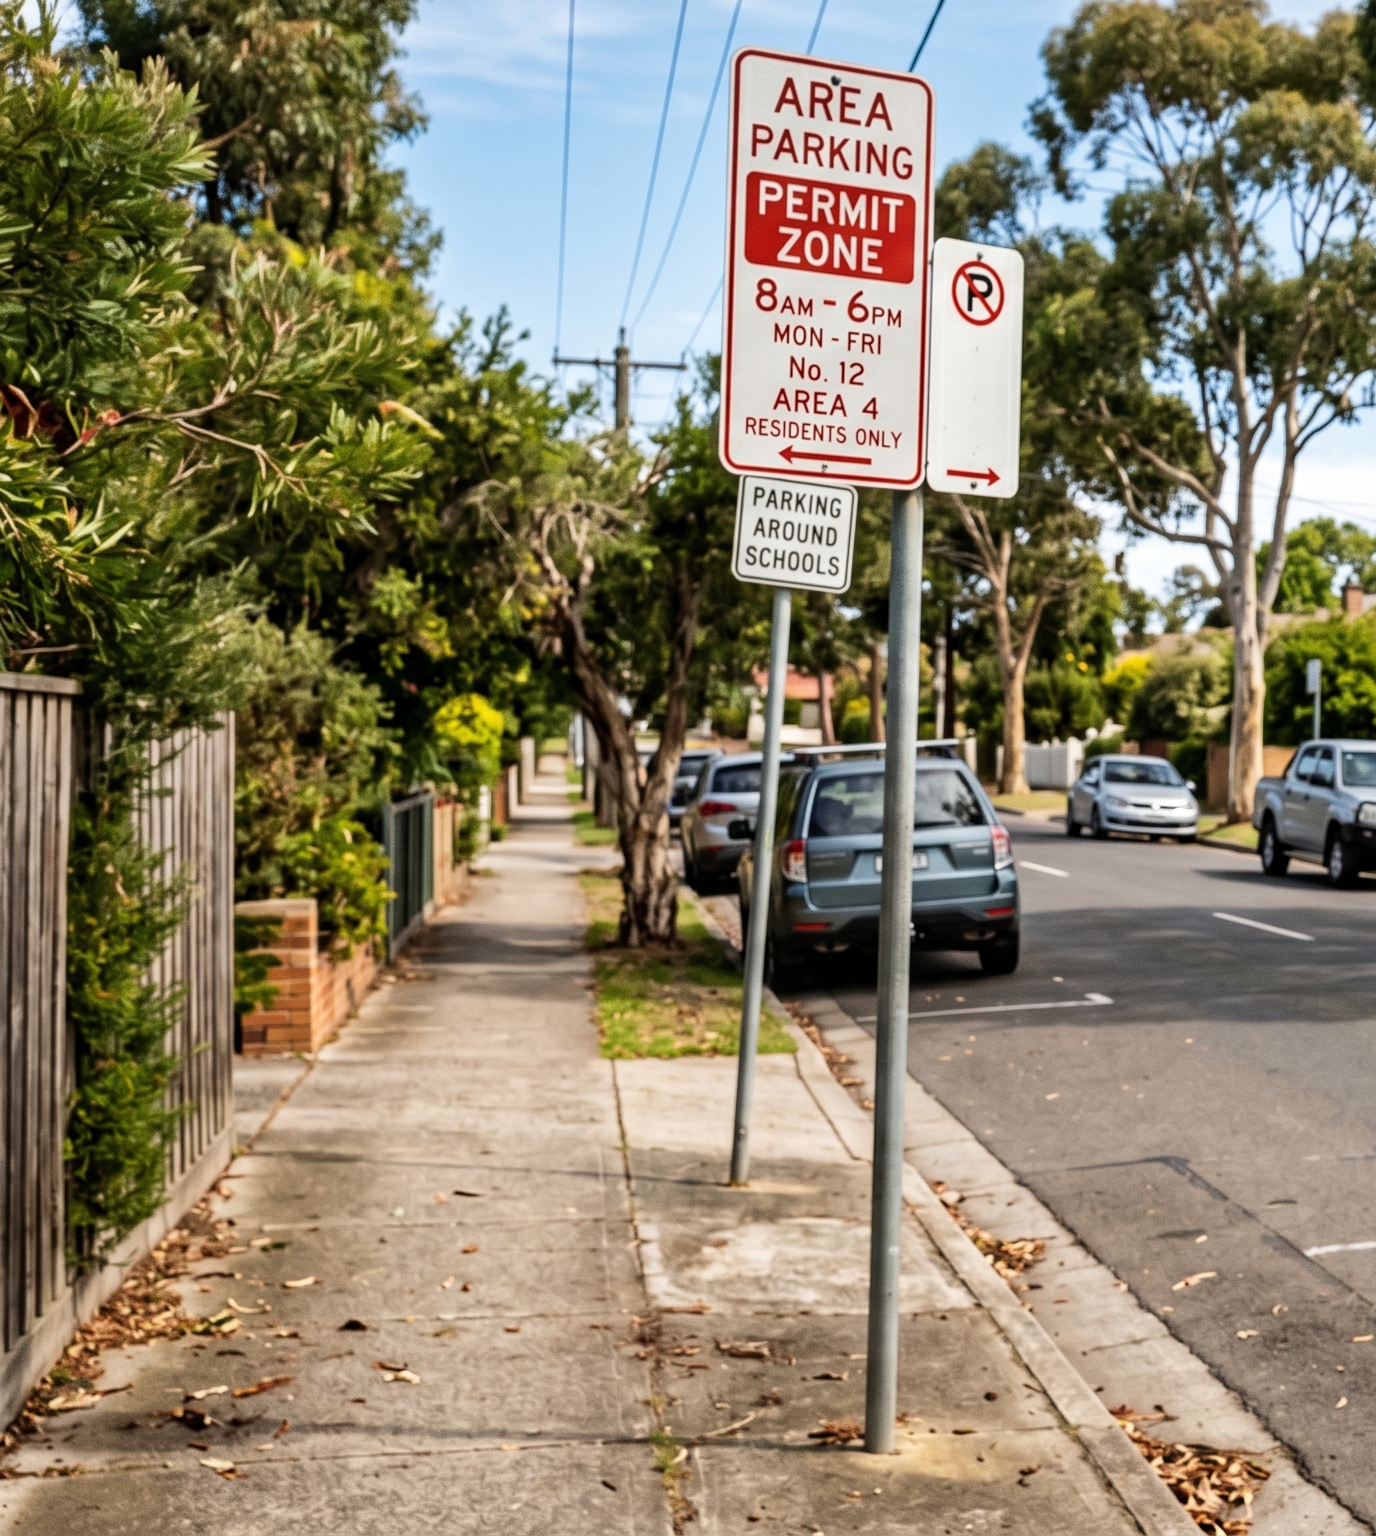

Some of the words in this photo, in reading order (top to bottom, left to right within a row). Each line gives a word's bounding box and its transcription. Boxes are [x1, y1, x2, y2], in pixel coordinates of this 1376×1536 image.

[773, 77, 893, 131] AREA
[751, 123, 913, 180] PARKING
[758, 179, 904, 233] PERMIT
[776, 226, 883, 274] ZONE
[755, 278, 813, 317] 8AM
[847, 290, 902, 328] 6PM
[967, 272, 993, 312] P
[774, 323, 823, 348] MON
[847, 331, 882, 355] FRI
[789, 355, 828, 382] No.
[839, 361, 865, 386] 12
[773, 388, 847, 417] AREA
[861, 397, 878, 420] 4
[745, 416, 847, 443] RESIDENTS
[855, 428, 902, 449] ONLY
[753, 486, 842, 518] PARKING
[753, 517, 837, 546] AROUND
[745, 545, 840, 576] SCHOOLS
